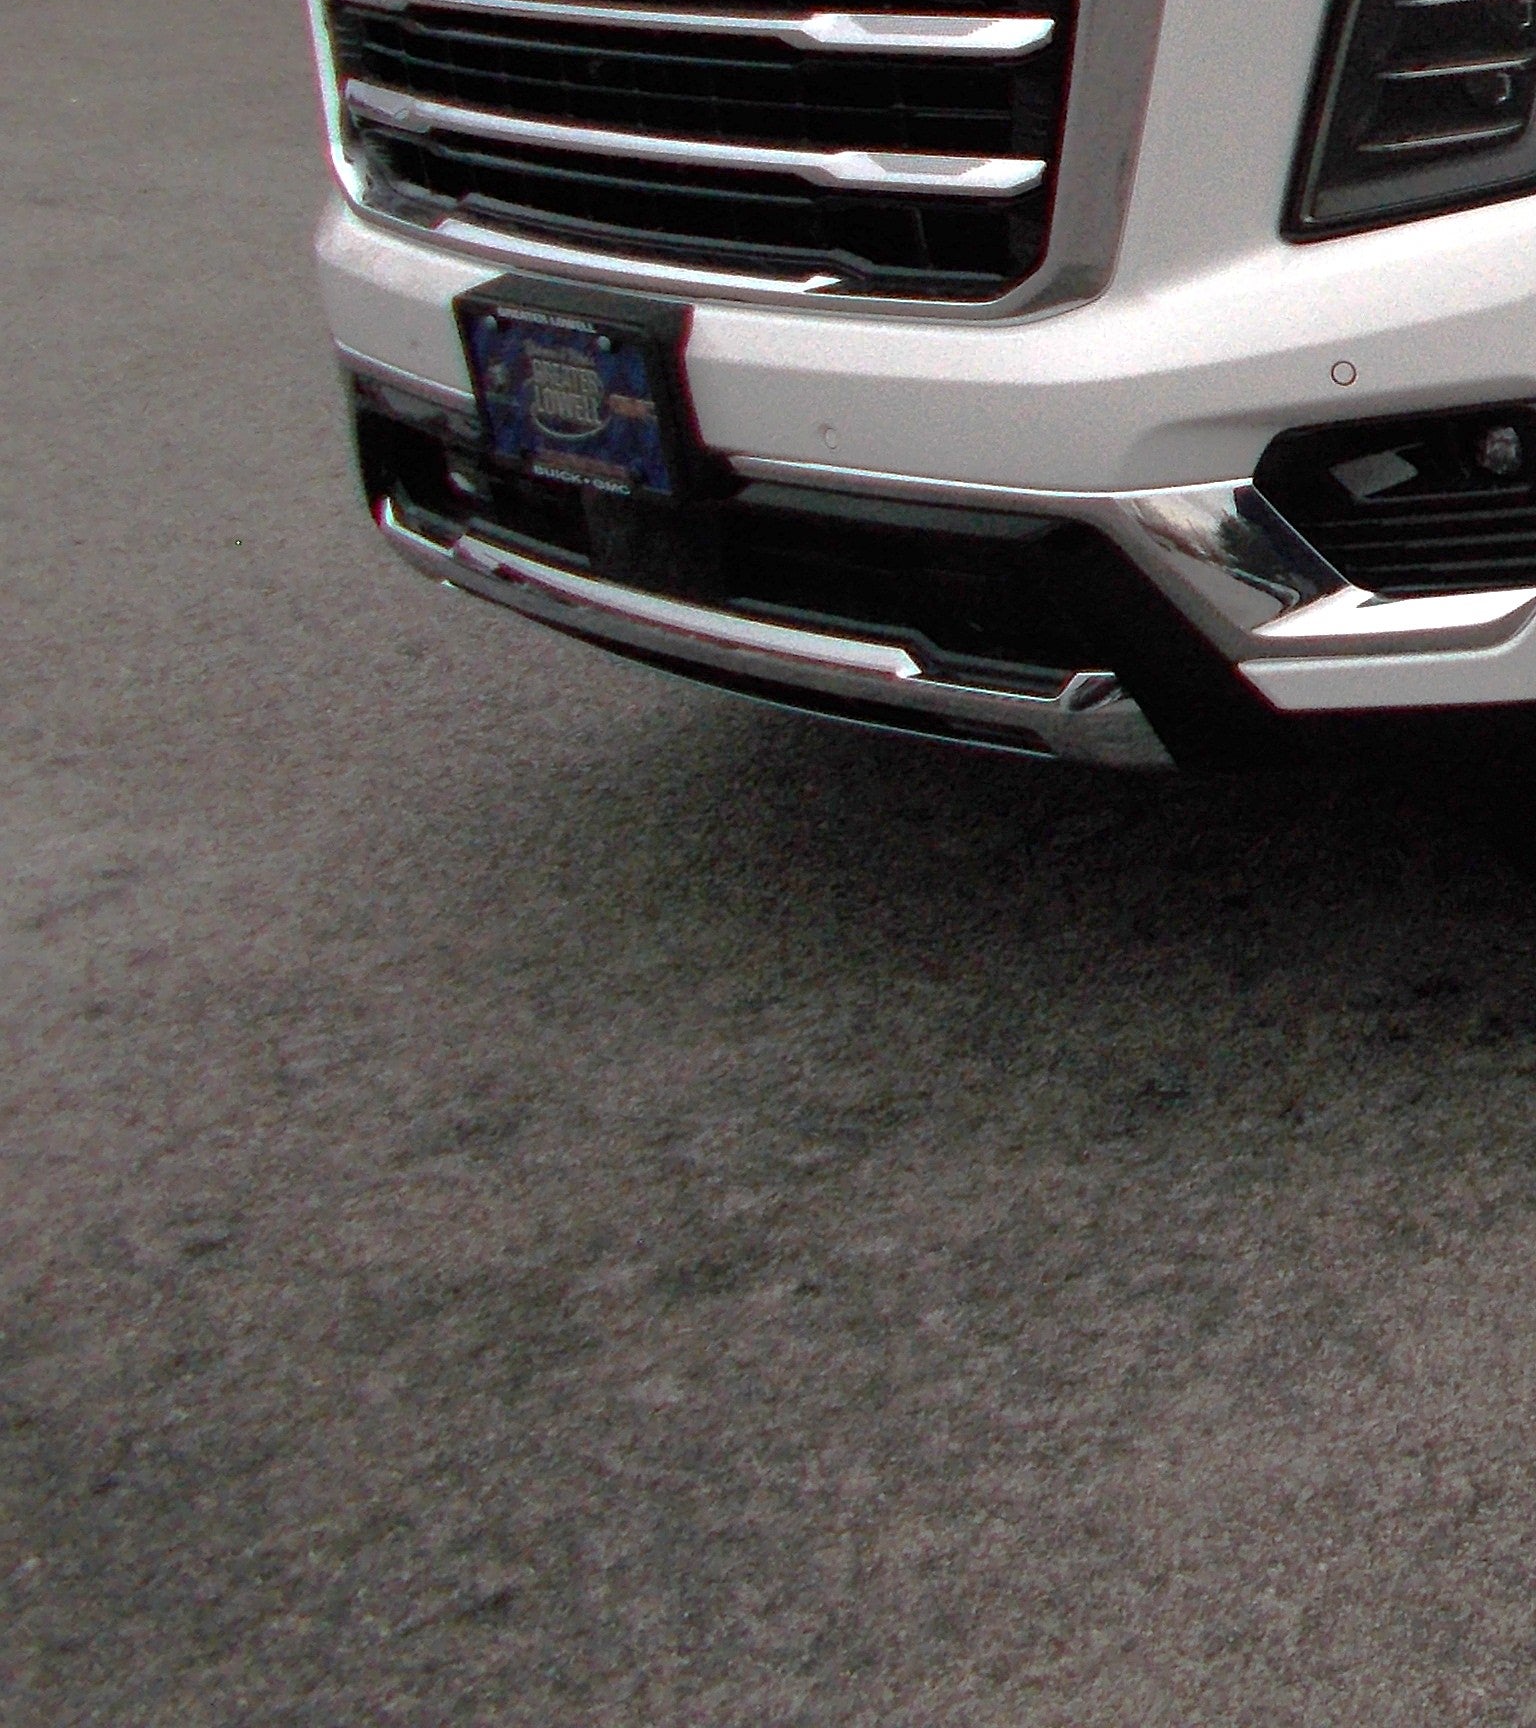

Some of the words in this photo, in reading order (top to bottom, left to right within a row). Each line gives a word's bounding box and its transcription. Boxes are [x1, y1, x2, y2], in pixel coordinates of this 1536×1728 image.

[532, 358, 601, 393] GREATER
[533, 384, 602, 425] LOWELL
[533, 464, 582, 484] BUICK
[593, 478, 631, 495] GMC
